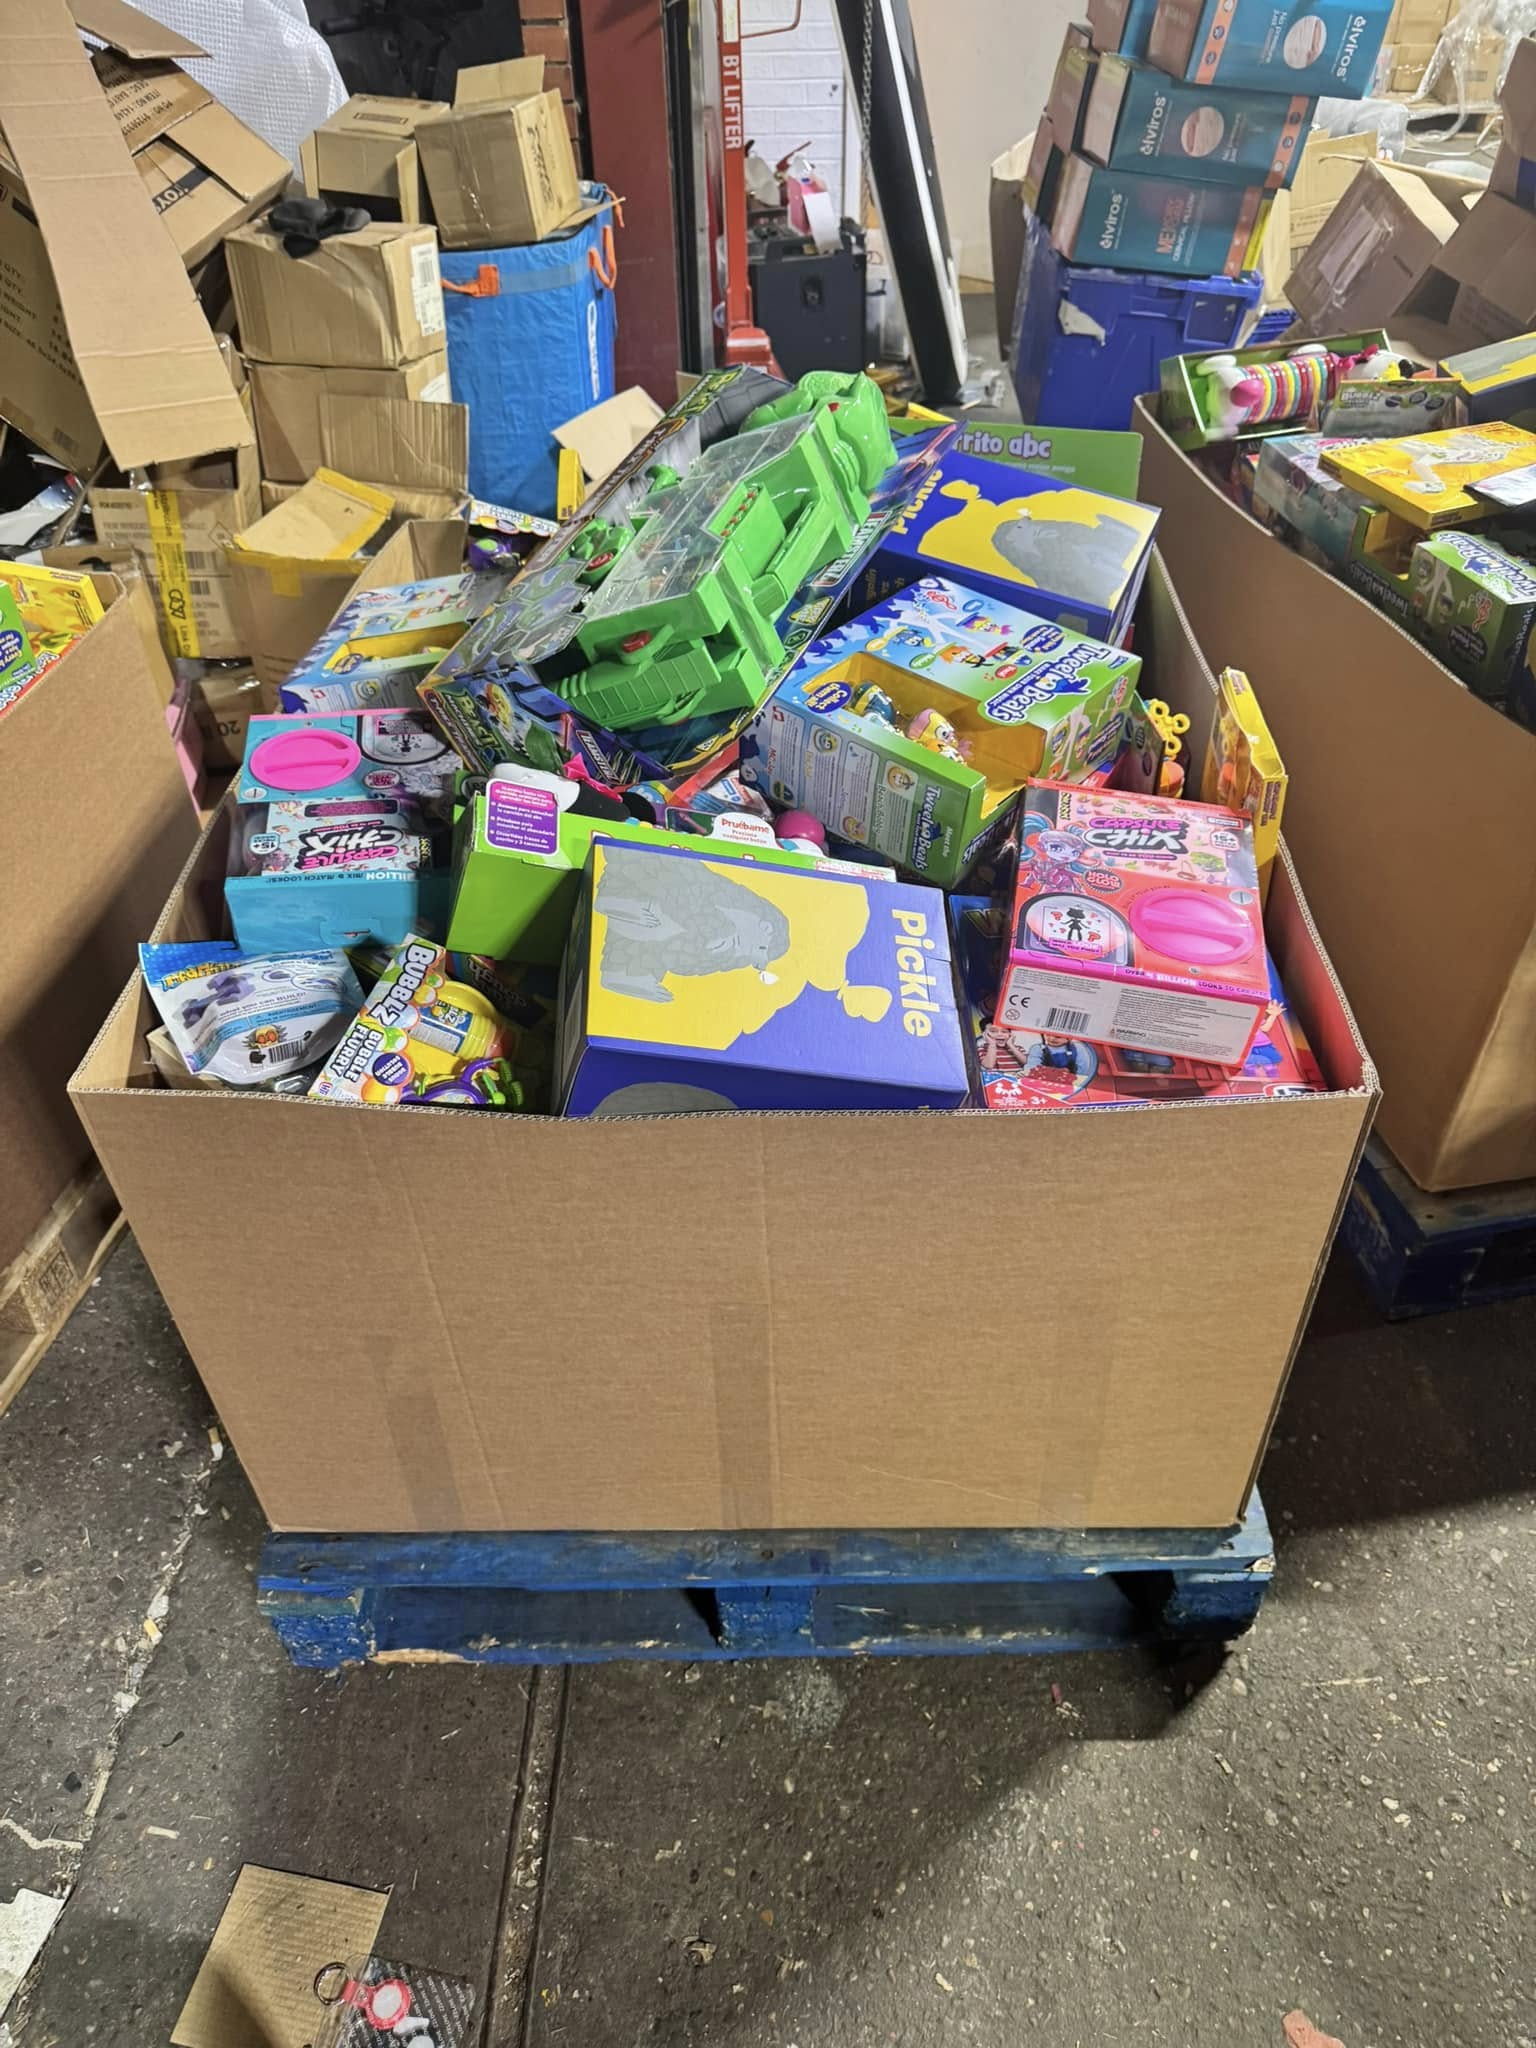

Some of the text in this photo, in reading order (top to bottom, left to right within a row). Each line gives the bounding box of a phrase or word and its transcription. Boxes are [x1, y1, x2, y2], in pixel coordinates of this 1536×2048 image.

[722, 55, 742, 149] BT LIFTER
[952, 432, 1051, 458] rrito abc
[456, 693, 496, 750] BEAST
[943, 826, 953, 857] Meet the
[1089, 816, 1182, 830] CAPSULE
[301, 846, 399, 870] CAPSULE
[304, 873, 334, 881] MATCH
[369, 942, 438, 1028] BUBBLZ
[891, 907, 940, 1039] Pickle
[328, 1024, 366, 1079] FLURRY
[345, 1029, 385, 1083] BUBBLE
[1031, 1094, 1048, 1107] 3+
